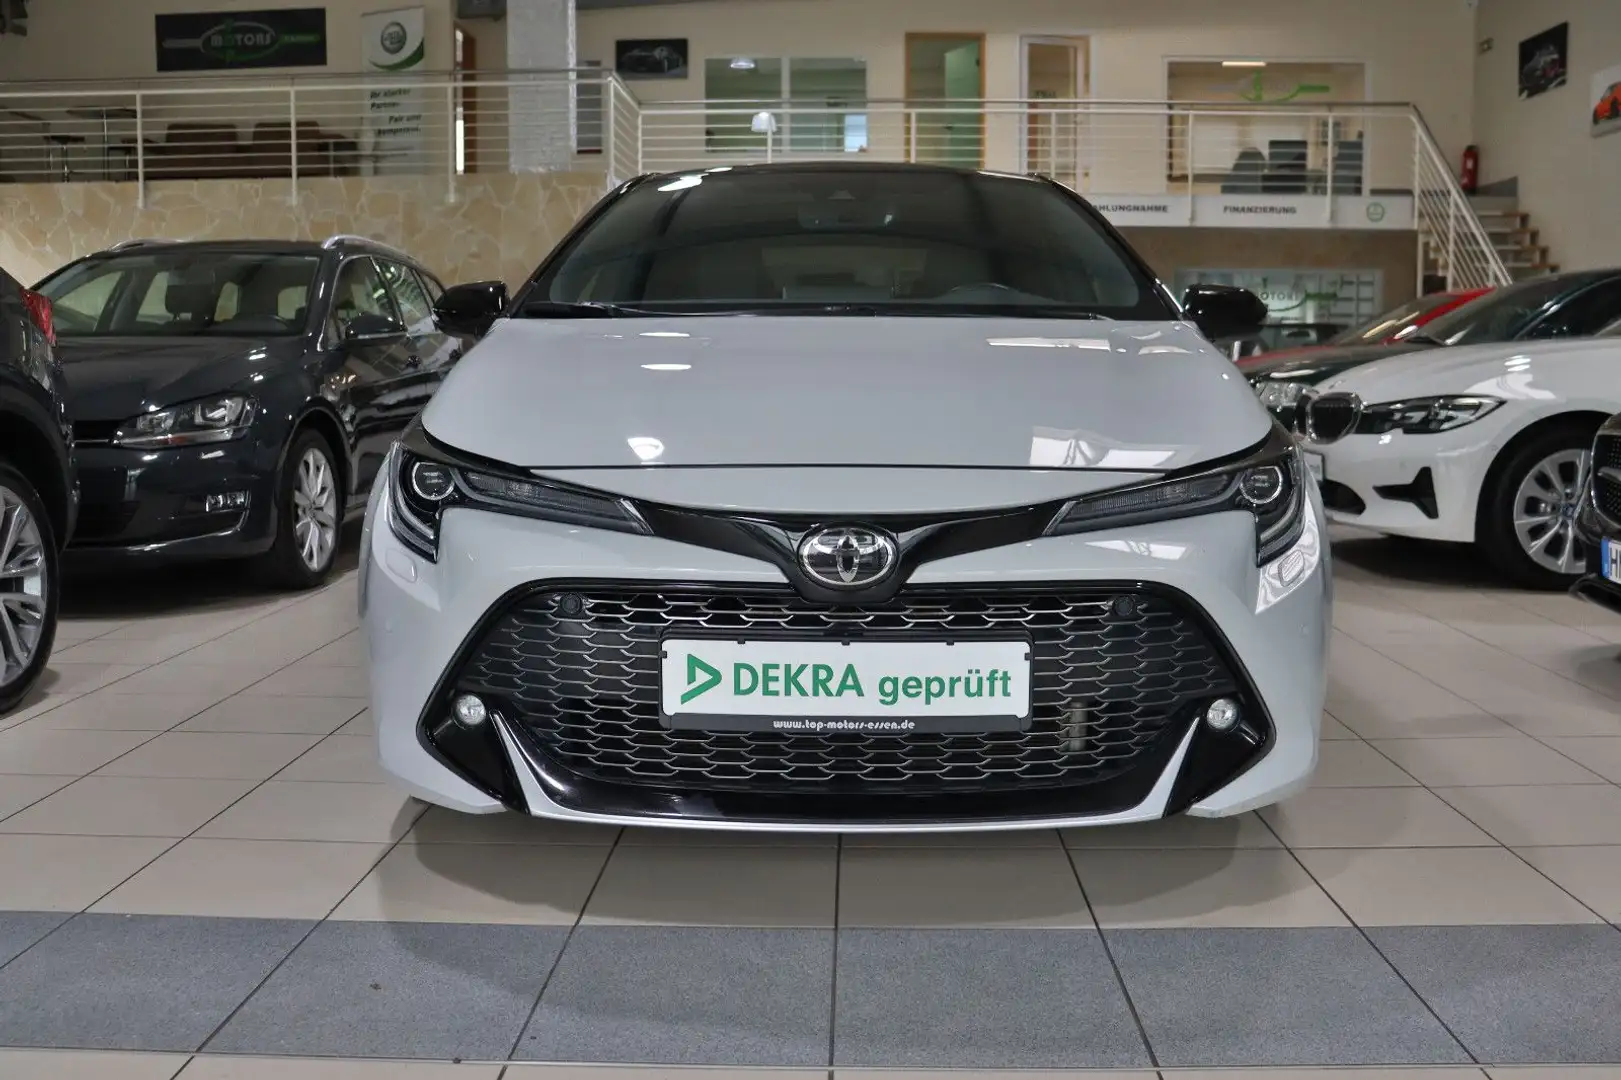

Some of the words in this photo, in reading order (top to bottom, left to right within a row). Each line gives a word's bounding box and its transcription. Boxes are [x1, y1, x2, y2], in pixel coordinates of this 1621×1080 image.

[1223, 206, 1297, 214] FINANZIERUNG
[1256, 291, 1301, 302] OTORS
[733, 662, 865, 697] DEKRA
[878, 669, 1012, 705] geprüft
[773, 718, 916, 731] www.top-motors-essen.de
